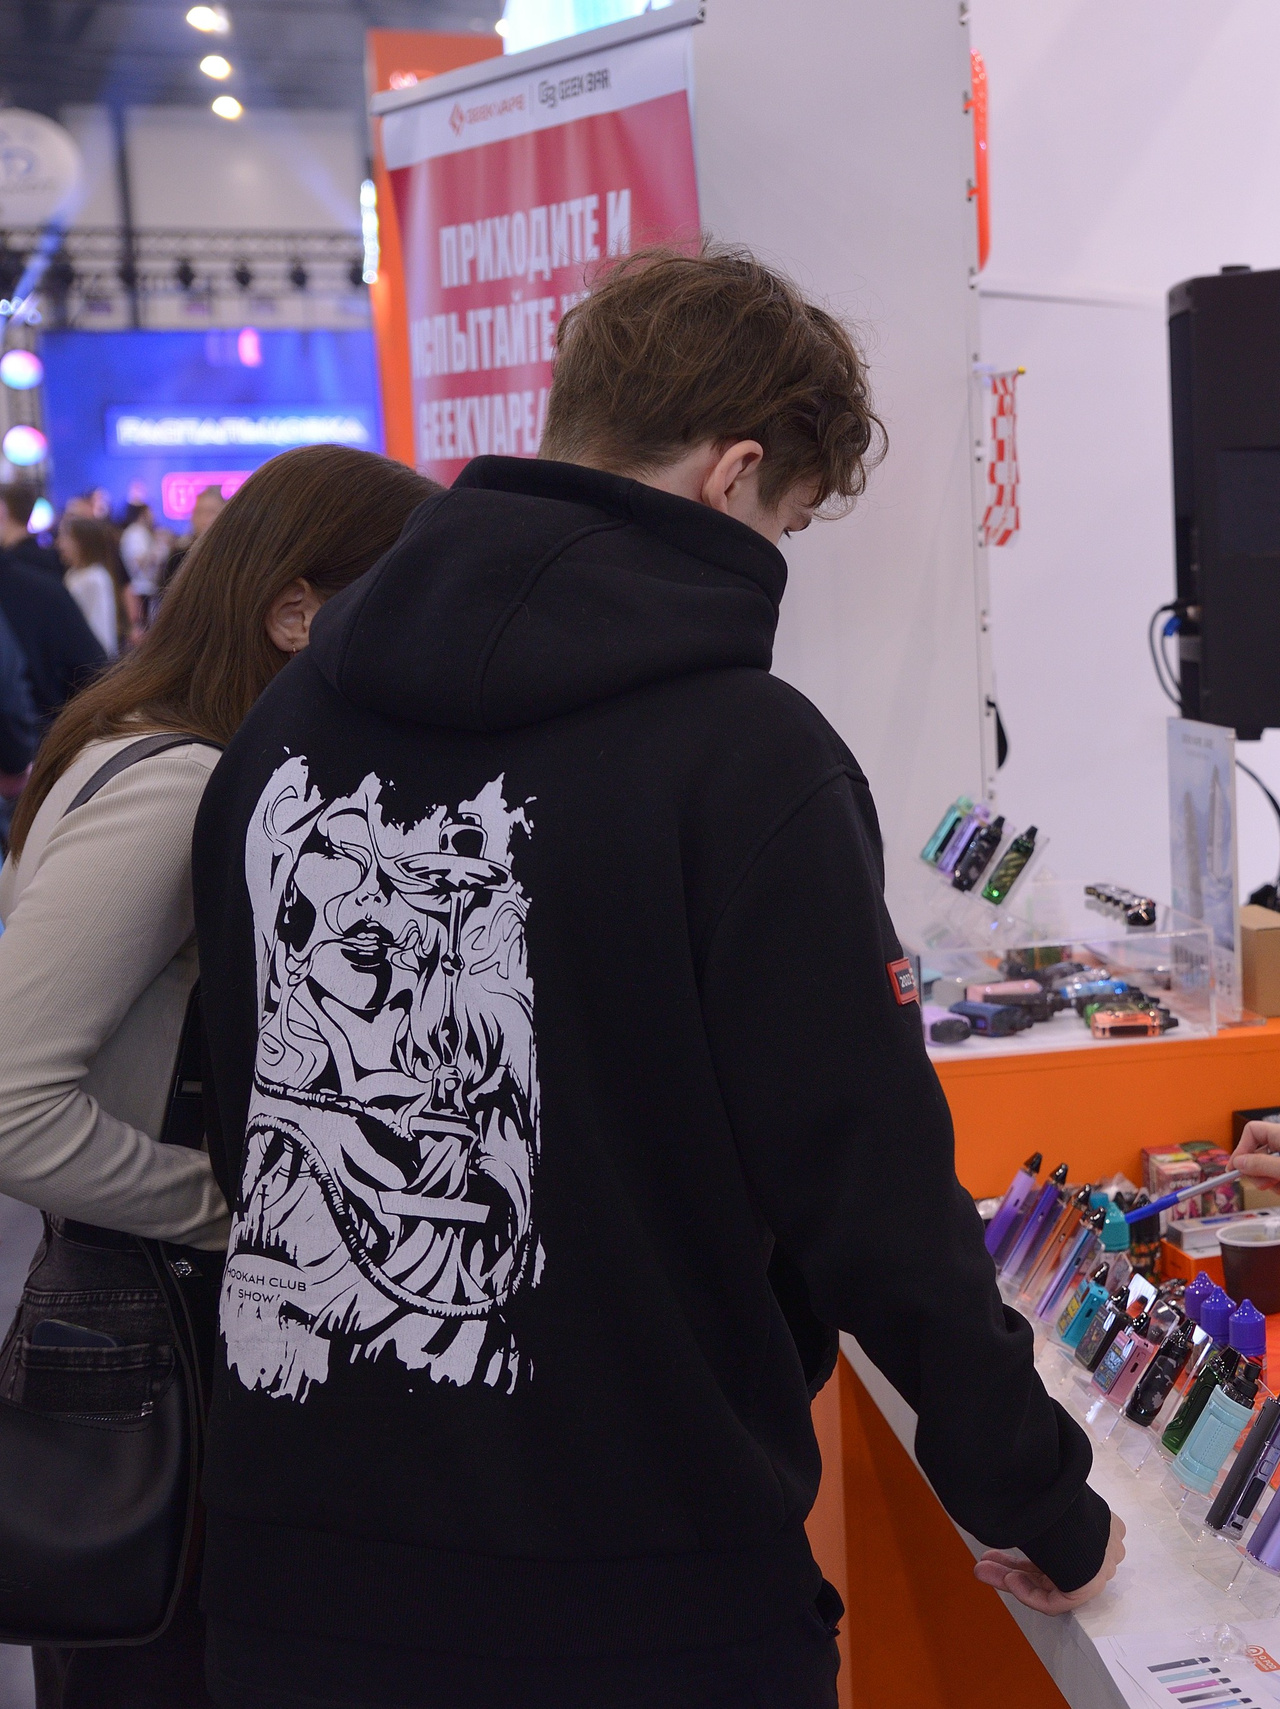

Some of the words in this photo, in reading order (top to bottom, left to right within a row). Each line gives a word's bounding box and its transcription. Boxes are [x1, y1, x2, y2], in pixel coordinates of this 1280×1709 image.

[439, 193, 599, 289] ПРИХОДИТЕ
[606, 188, 631, 258] И
[228, 1267, 265, 1286] HOOKAH
[268, 1277, 307, 1293] CLUB
[238, 1288, 275, 1304] SHOW
